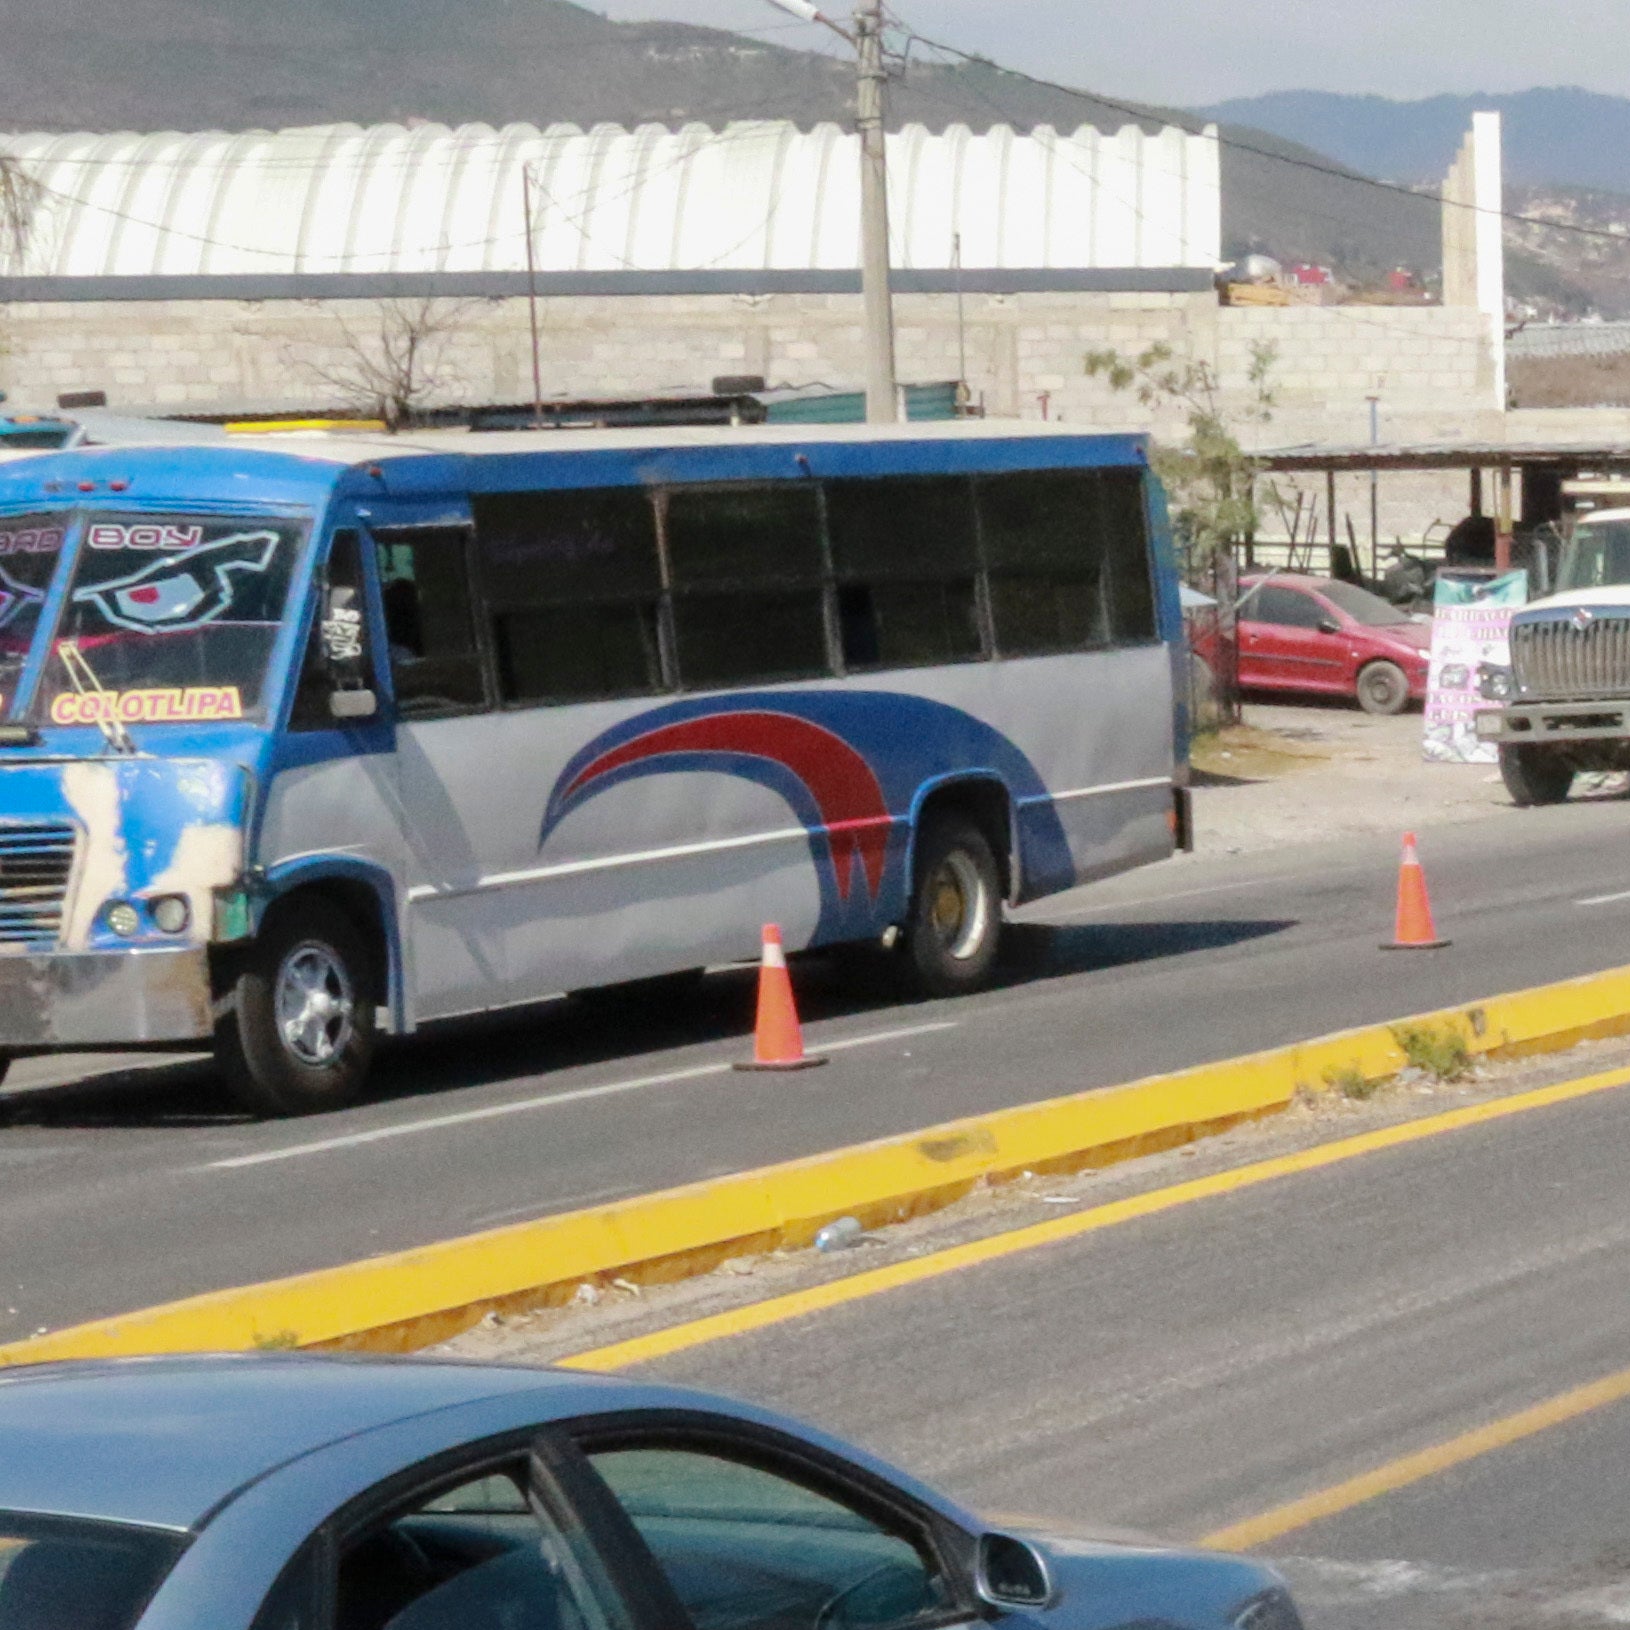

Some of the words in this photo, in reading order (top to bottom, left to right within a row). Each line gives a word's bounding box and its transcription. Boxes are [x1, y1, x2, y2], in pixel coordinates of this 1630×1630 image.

[88, 524, 202, 549] BOY
[1435, 607, 1512, 622] BARBACO
[53, 688, 239, 723] COLOTLIPA
